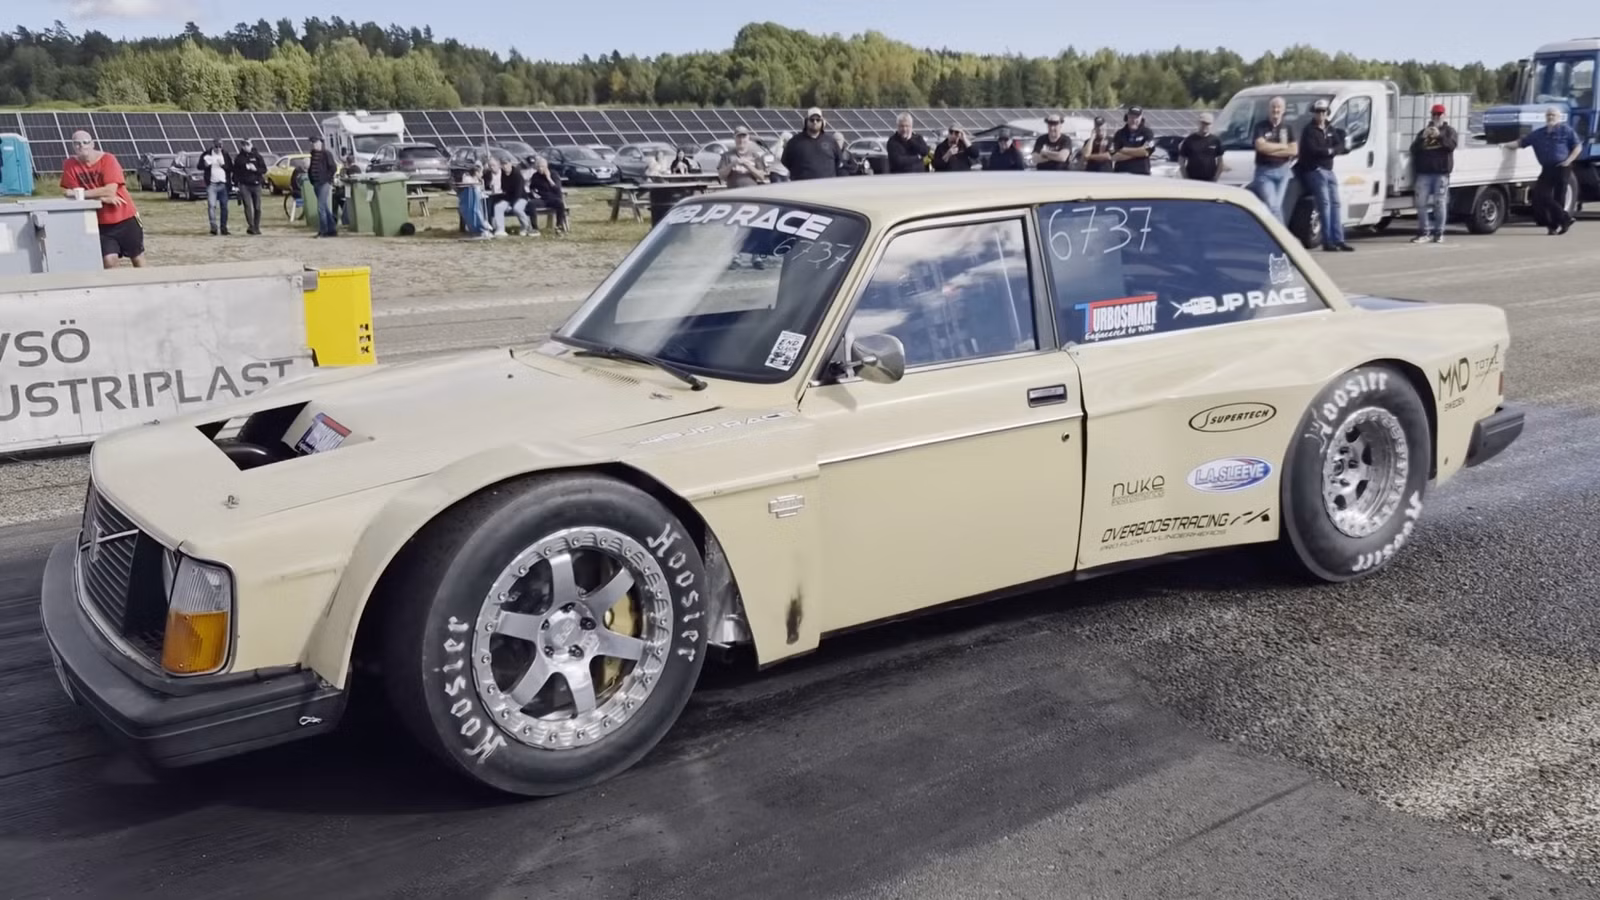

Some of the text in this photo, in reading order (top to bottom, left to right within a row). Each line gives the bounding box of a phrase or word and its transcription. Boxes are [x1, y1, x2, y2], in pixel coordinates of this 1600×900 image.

[726, 204, 833, 240] RACE
[1048, 205, 1152, 260] 6737
[773, 237, 853, 271] 6737
[1074, 292, 1158, 335] TURBOSMART
[1190, 287, 1307, 316] BJP RACE
[1438, 357, 1470, 402] MAD
[1209, 409, 1270, 425] SUPERTECH
[1112, 475, 1165, 498] nuke
[1101, 513, 1230, 544] OVERBOOSTRACING
[646, 522, 705, 662] Hoosier
[432, 615, 507, 764] Hoosier
